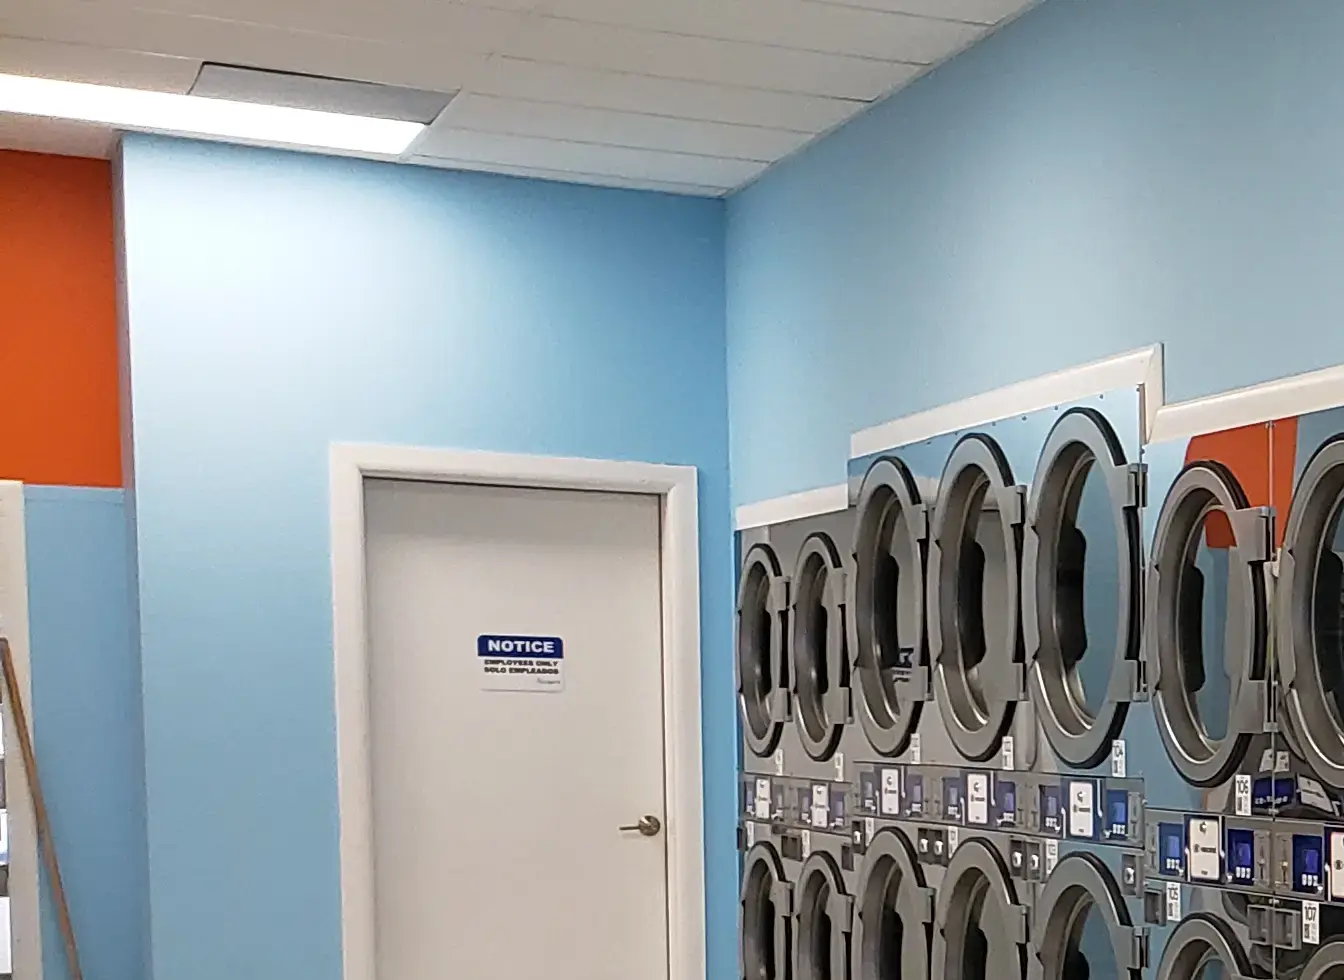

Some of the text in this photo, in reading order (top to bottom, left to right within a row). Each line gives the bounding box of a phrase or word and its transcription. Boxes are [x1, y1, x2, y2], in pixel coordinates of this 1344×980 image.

[487, 639, 555, 653] NOTICE
[483, 666, 559, 675] SOLO EMPLEADOS
[1236, 779, 1249, 795] 106
[1304, 906, 1317, 922] 107
